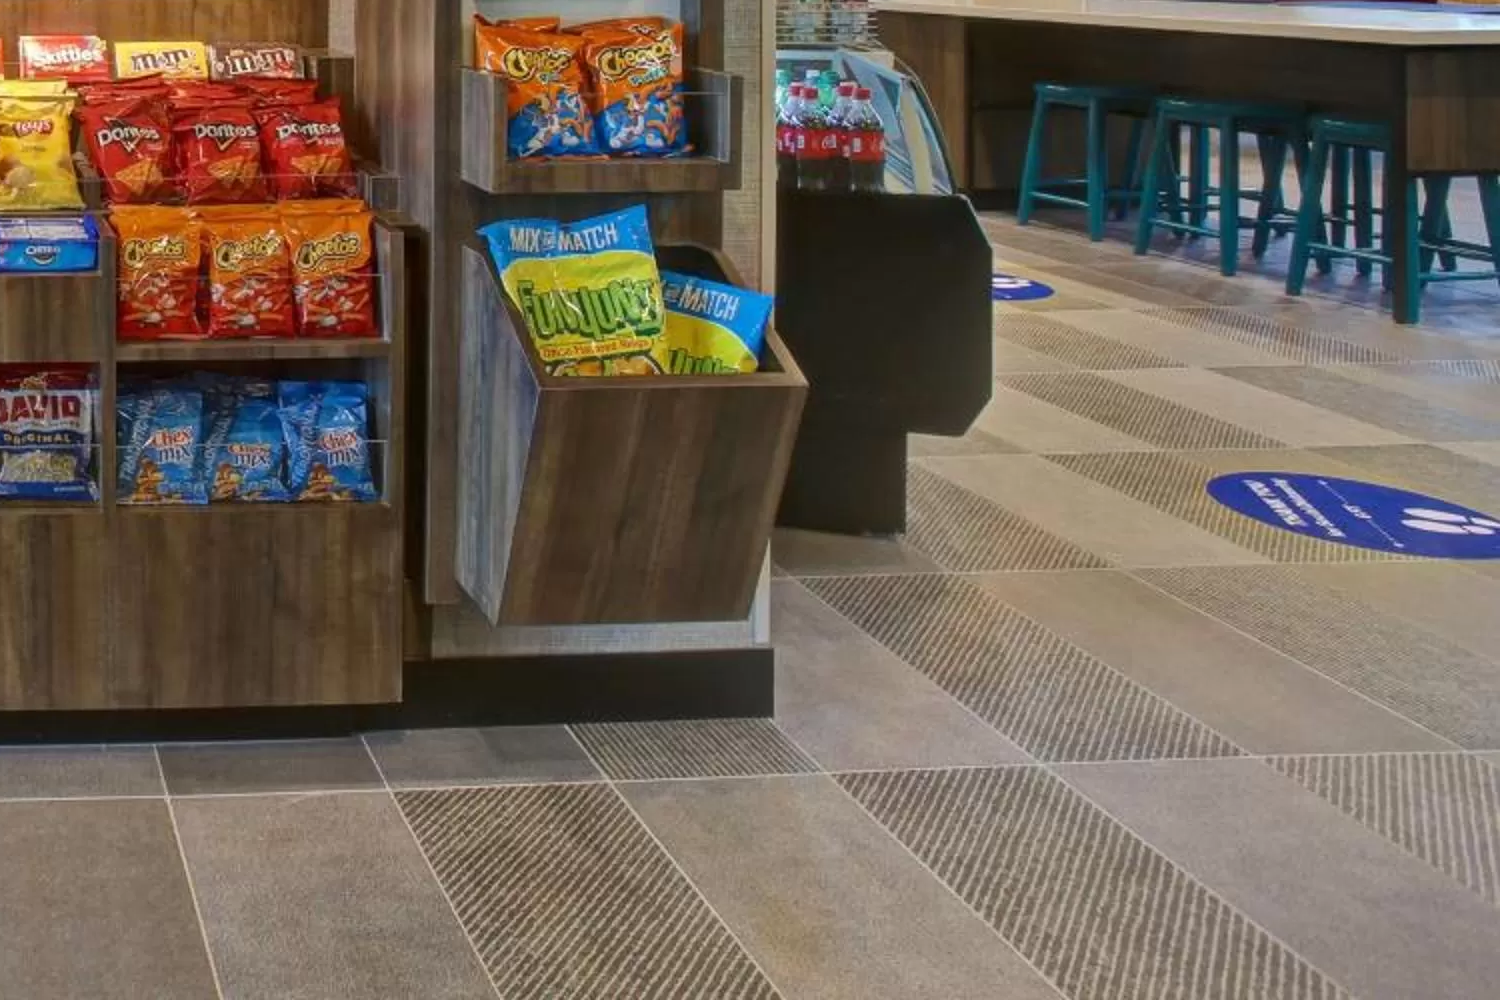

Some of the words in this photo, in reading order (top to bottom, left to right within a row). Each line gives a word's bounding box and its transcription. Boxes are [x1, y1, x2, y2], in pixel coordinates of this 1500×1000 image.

[97, 127, 160, 146] Doritos
[195, 123, 257, 139] Doritos
[509, 226, 541, 252] MIX
[557, 223, 618, 251] MATCH
[679, 284, 741, 322] MATCH
[3, 433, 72, 445] ORIGINAL
